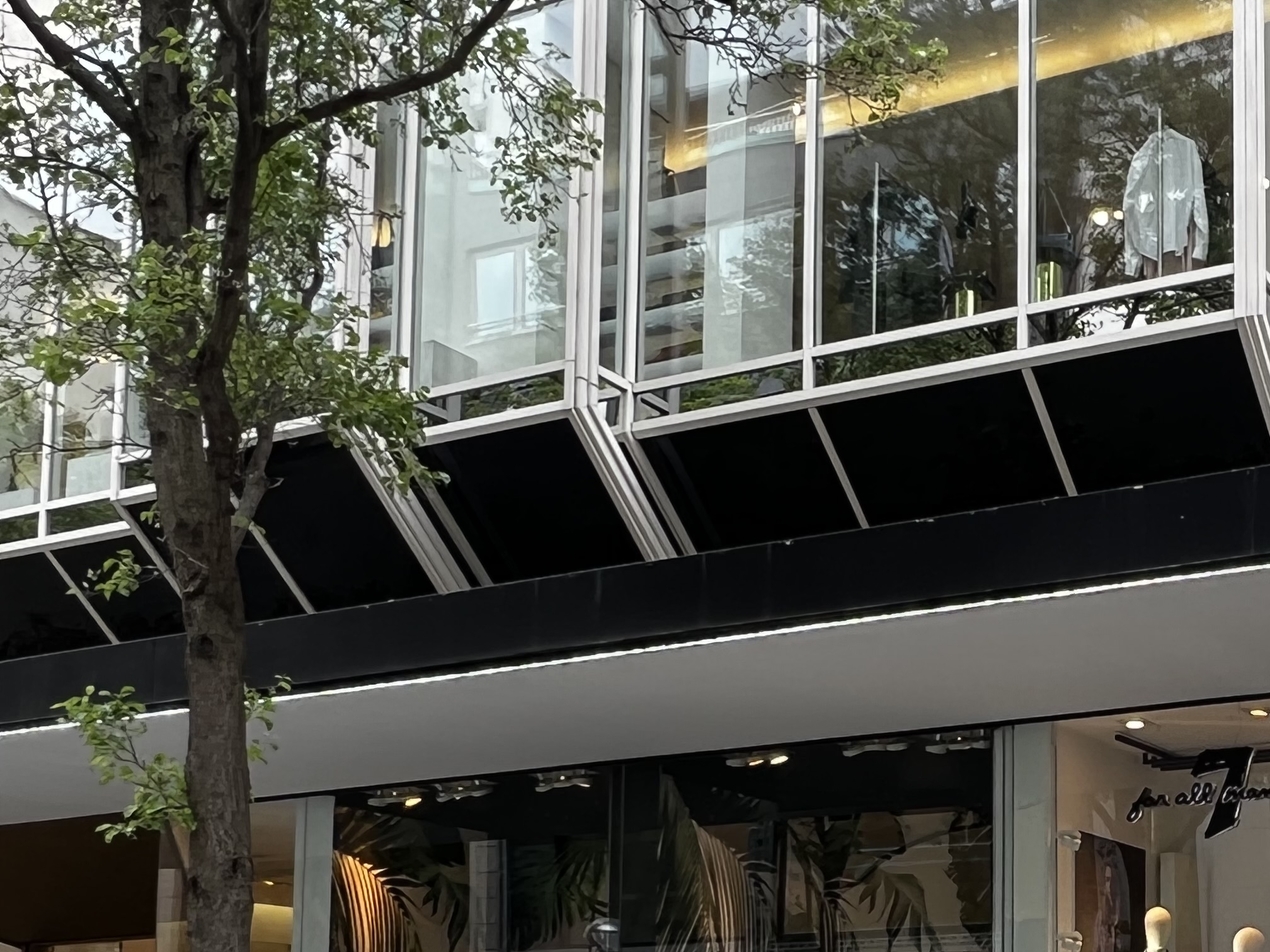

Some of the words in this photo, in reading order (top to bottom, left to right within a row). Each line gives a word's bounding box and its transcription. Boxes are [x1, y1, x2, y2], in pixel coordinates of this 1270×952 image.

[1126, 786, 1170, 823] for
[1174, 782, 1217, 806] all
[1191, 746, 1254, 839] 7
